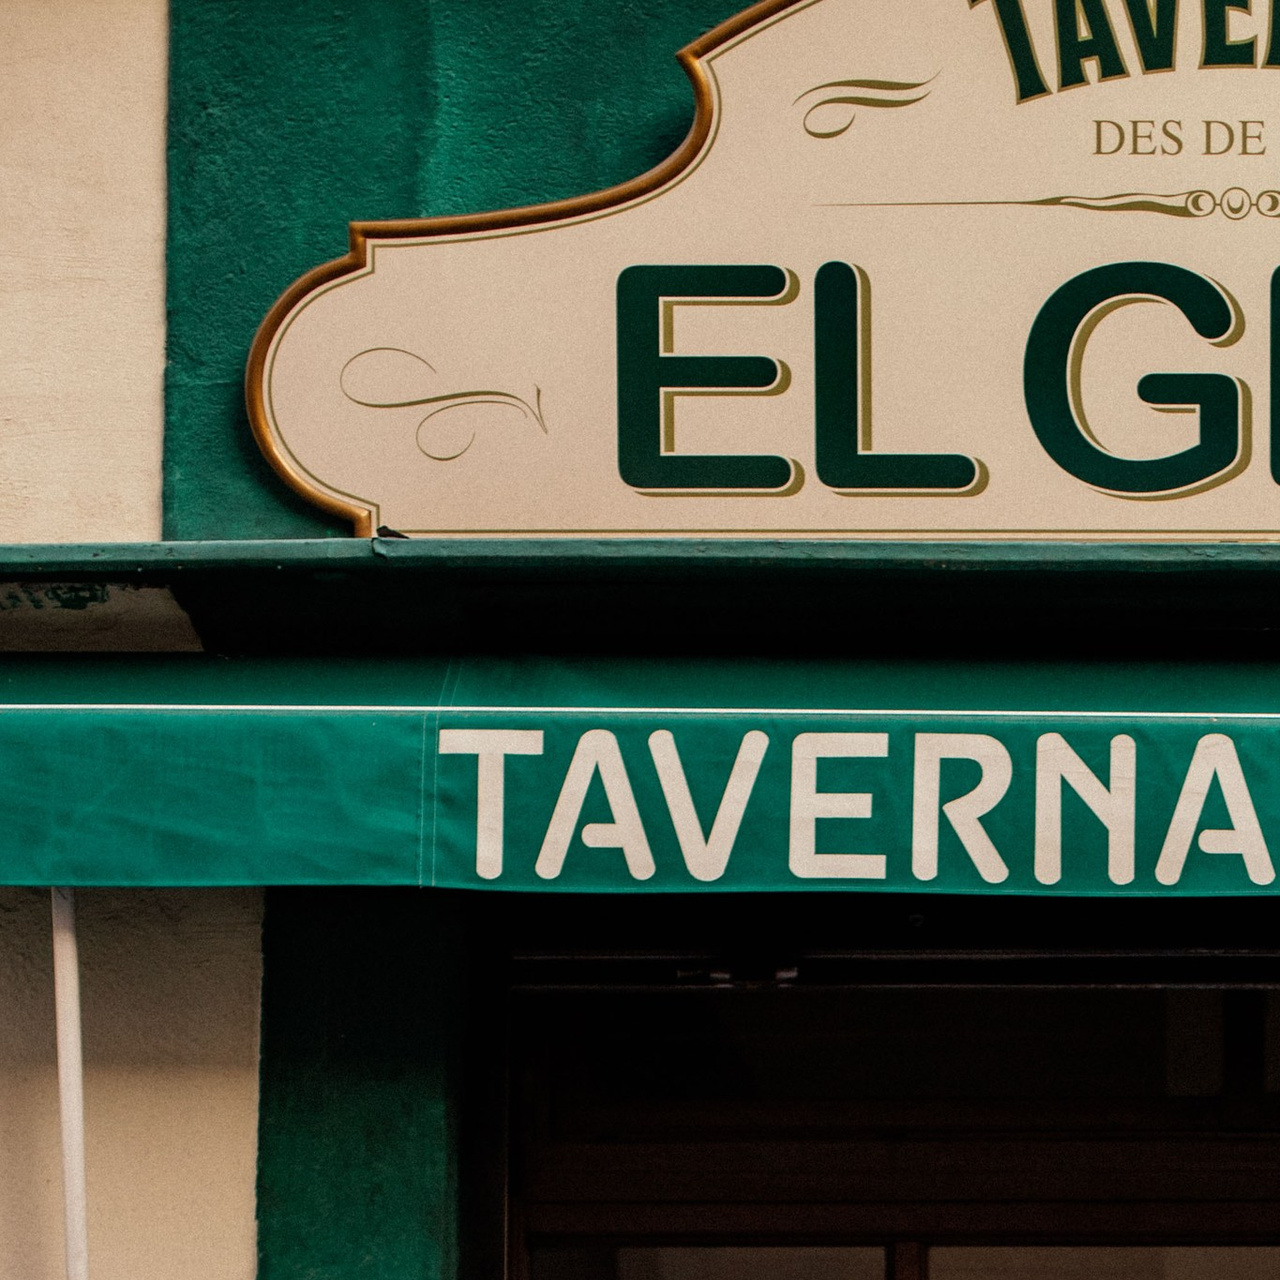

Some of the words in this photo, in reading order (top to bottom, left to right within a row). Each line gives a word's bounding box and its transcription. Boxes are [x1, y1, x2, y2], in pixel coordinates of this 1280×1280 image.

[1093, 119, 1184, 157] DES
[1202, 119, 1267, 156] DE
[616, 261, 990, 498] EL
[438, 728, 1277, 886] TAVERNA
